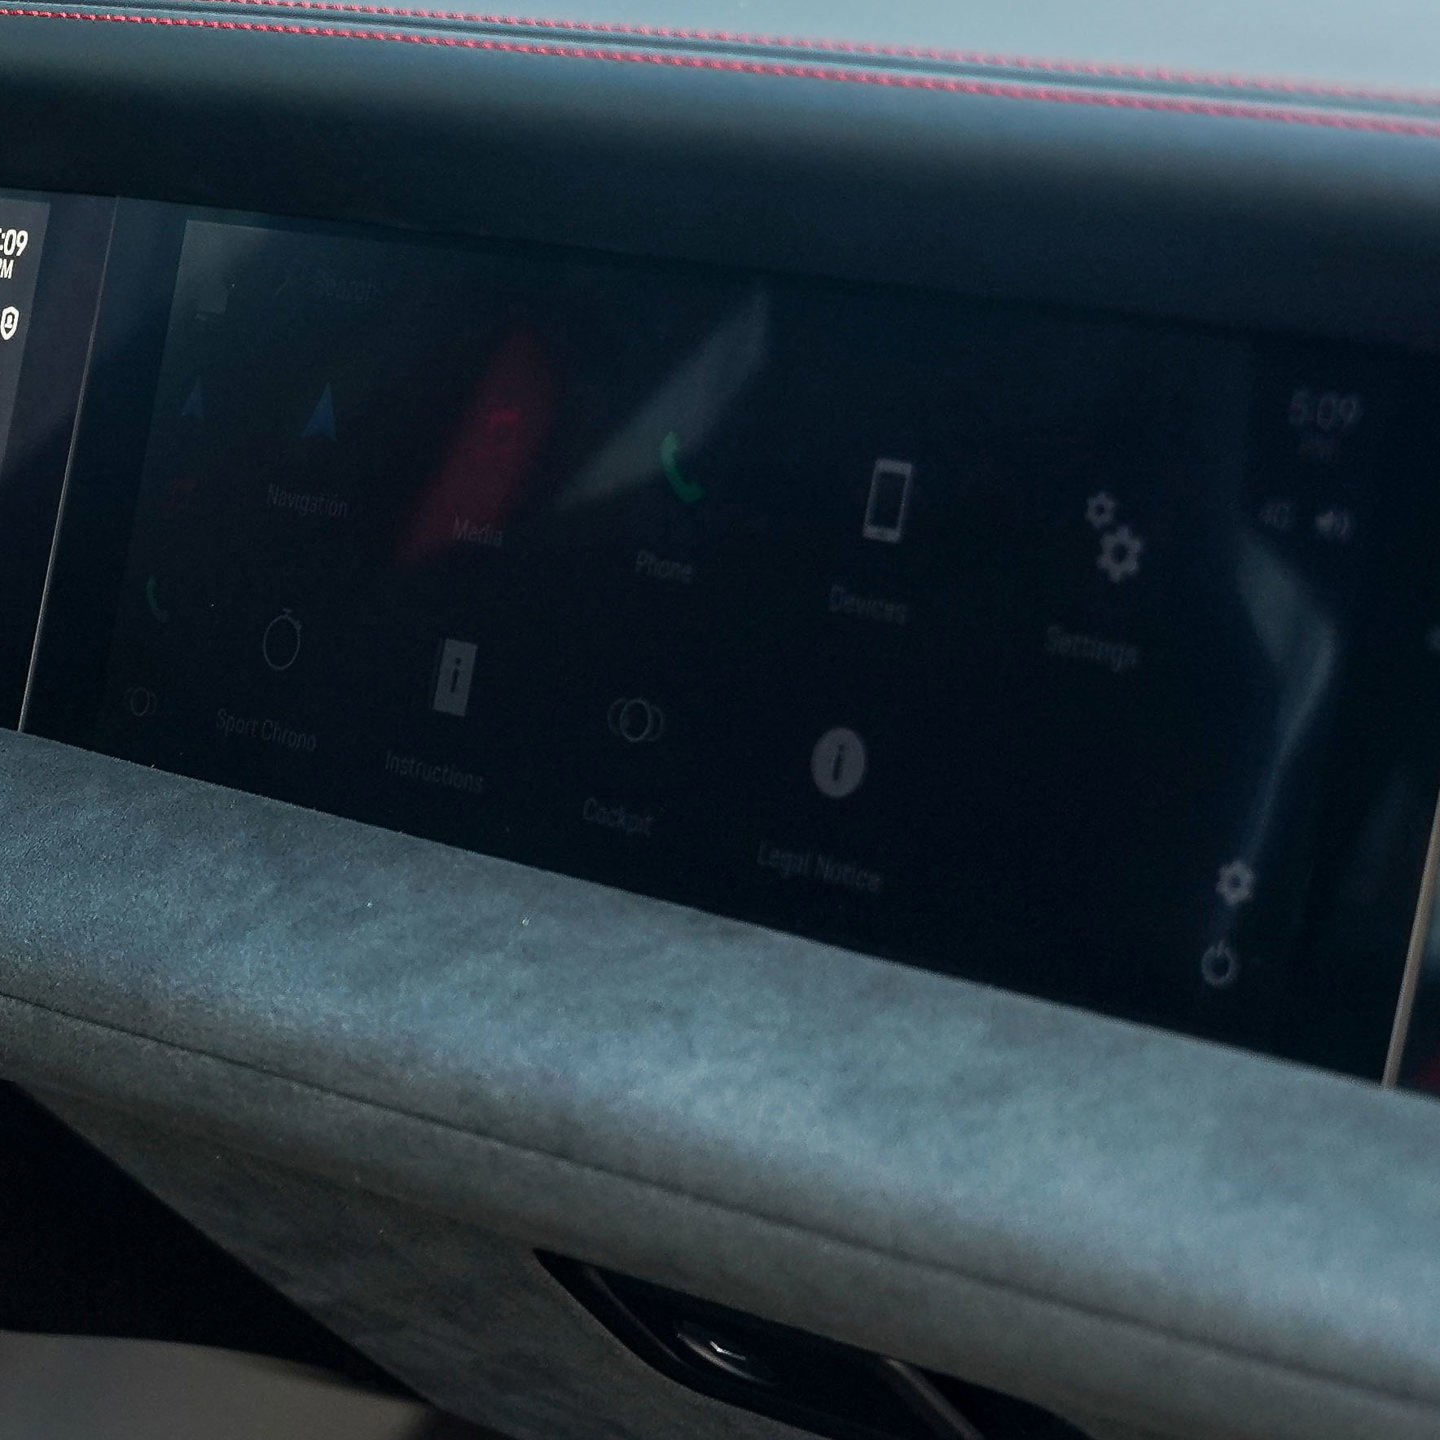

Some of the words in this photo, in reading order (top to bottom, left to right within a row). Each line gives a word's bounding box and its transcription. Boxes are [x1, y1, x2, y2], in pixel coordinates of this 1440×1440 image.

[266, 483, 349, 519] Navigation
[451, 517, 504, 548] Media
[634, 549, 694, 584] Phone
[828, 584, 908, 625] Devices
[1047, 624, 1139, 672] Settings
[216, 707, 259, 738] Sport
[261, 719, 317, 753] Chrono
[385, 750, 485, 795] Instructions
[583, 797, 654, 837] Cockpit
[757, 841, 810, 880] Legal
[819, 853, 884, 894] Notice
